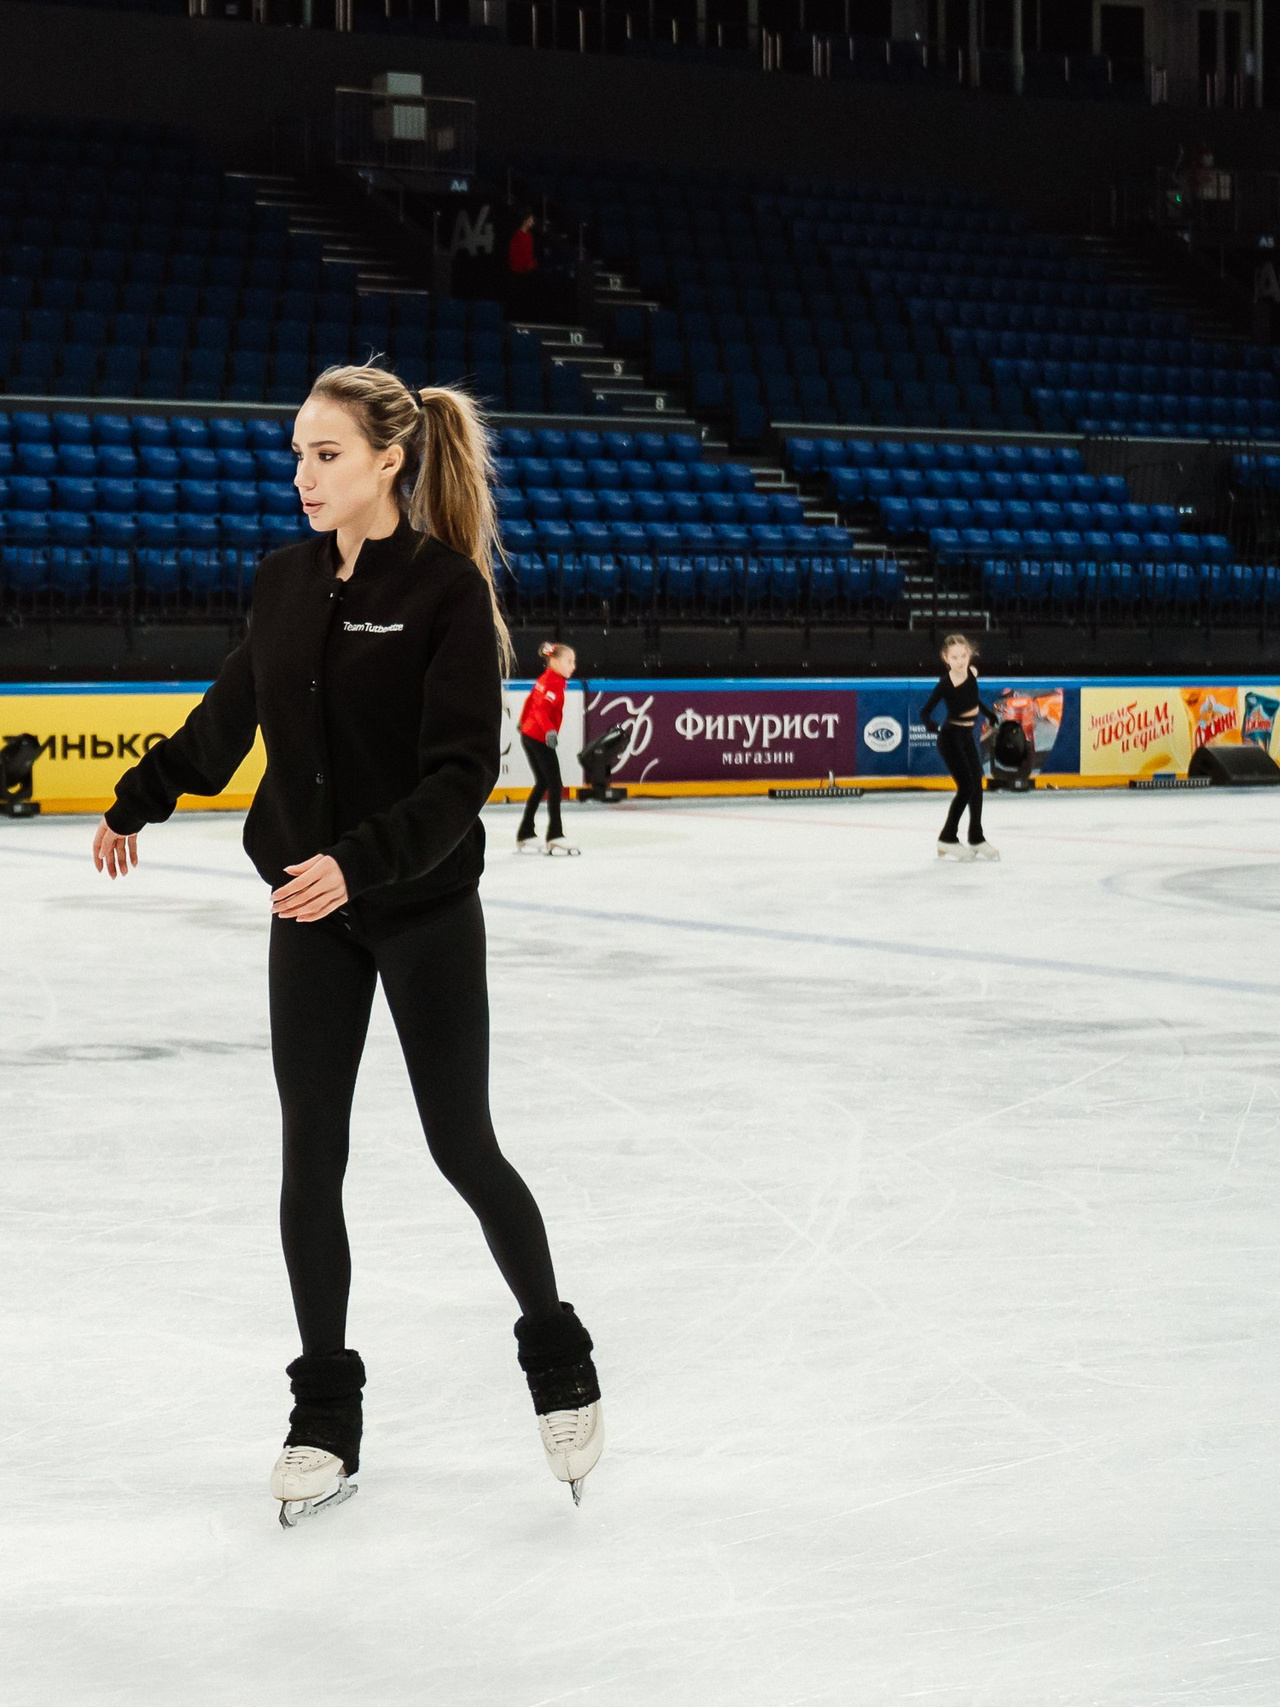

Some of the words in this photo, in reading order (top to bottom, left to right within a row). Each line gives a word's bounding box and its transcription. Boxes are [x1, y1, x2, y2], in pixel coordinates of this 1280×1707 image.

[570, 332, 584, 345] 10
[613, 362, 624, 376] 9
[674, 707, 840, 749] Фигурист
[1093, 700, 1169, 751] любим
[1121, 739, 1130, 753] и
[722, 751, 795, 765] магазин
